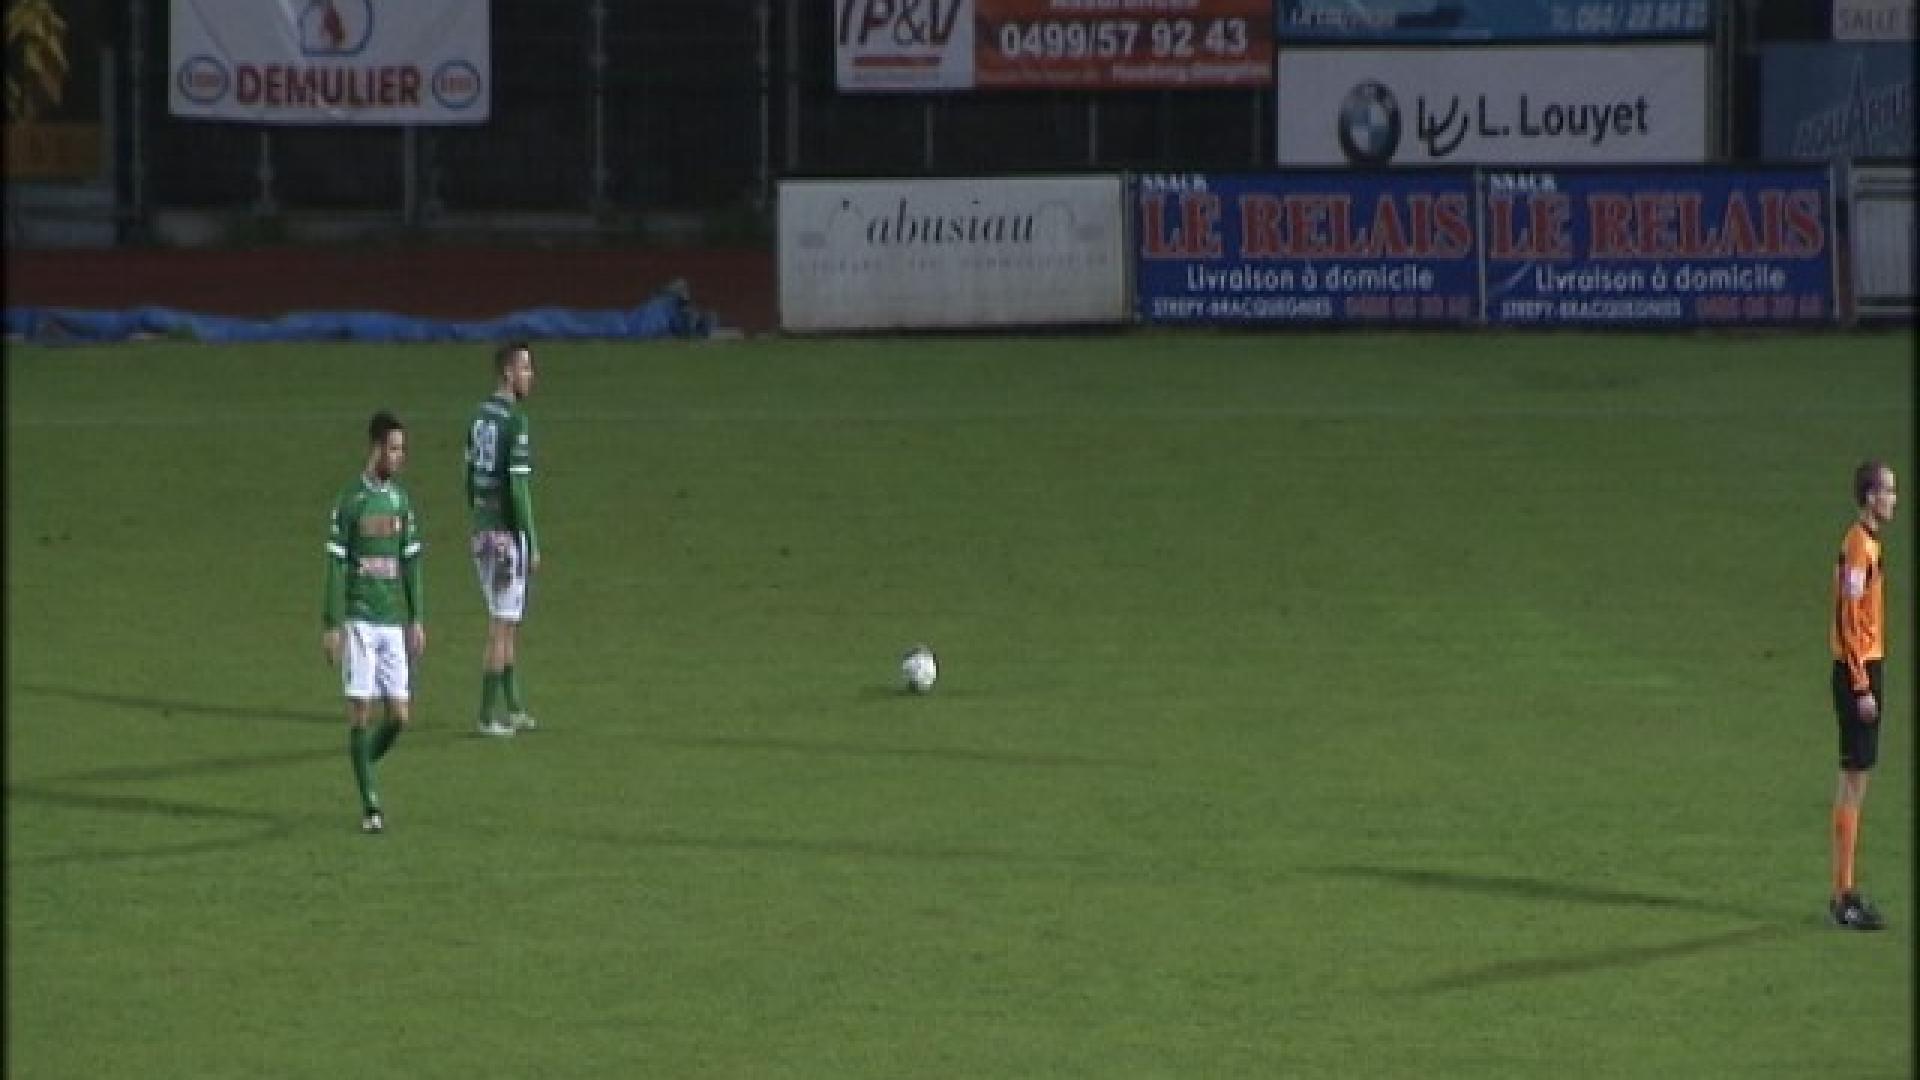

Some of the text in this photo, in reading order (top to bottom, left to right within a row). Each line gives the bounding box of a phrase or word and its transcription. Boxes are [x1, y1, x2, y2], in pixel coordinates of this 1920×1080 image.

[1002, 21, 1139, 59] 0499/57
[1150, 19, 1196, 58] 92
[1203, 17, 1250, 56] 43
[236, 64, 422, 109] DEMULIER
[1519, 94, 1651, 147] Louyet
[1141, 191, 1473, 259] LE RELAIS
[1489, 189, 1825, 259] LE RELAIS
[1187, 264, 1295, 291] Livraison
[1325, 263, 1435, 291] domicile
[1535, 263, 1645, 291] Livraison
[1675, 262, 1787, 291] domicile
